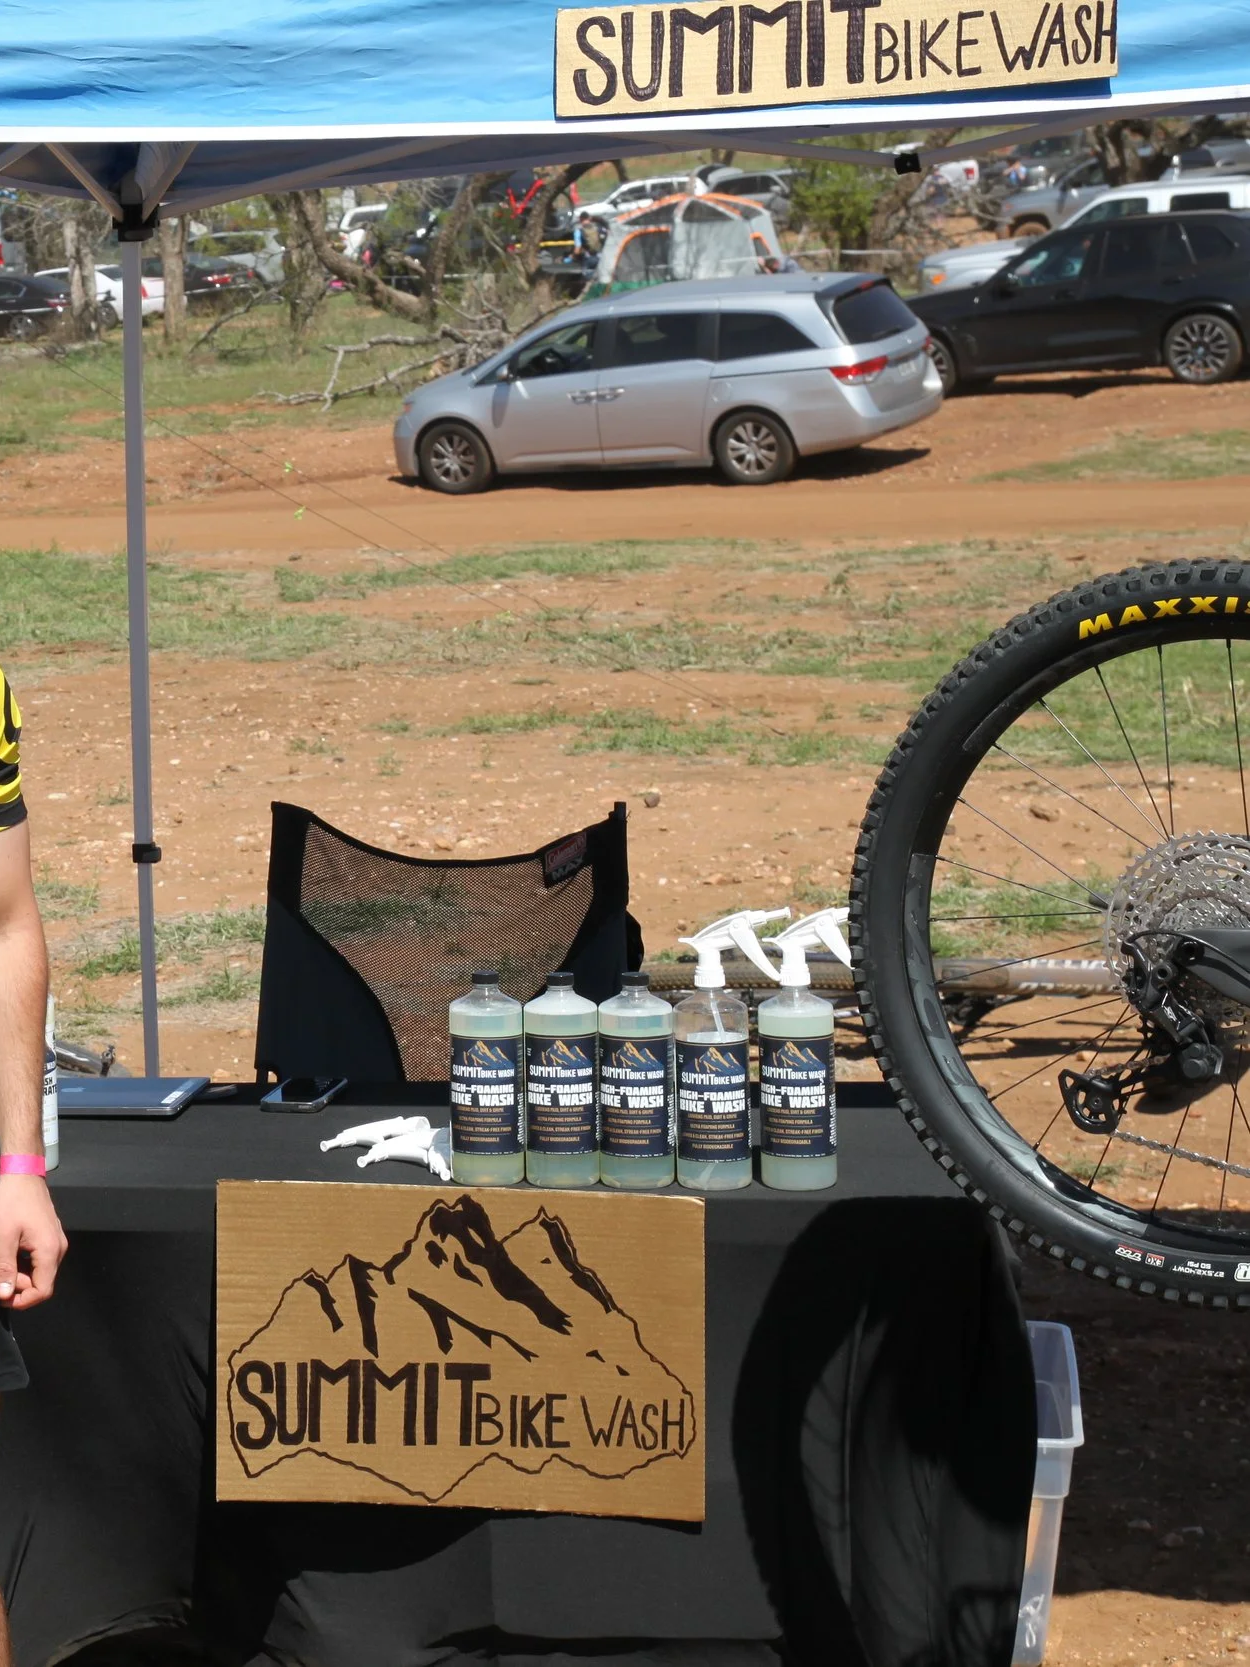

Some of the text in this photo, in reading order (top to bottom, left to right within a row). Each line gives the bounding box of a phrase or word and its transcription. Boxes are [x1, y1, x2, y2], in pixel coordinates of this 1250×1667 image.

[573, 0, 1117, 105] SUMMIT BIKE WASH
[1079, 596, 1250, 640] MAXXI
[452, 1064, 515, 1078] SUMMIT BIKE WASH
[529, 1064, 593, 1078] SUMMIT BIKE WASH
[601, 1065, 664, 1080] SUMMIT BIKE WASH
[681, 1071, 746, 1085] SUMMIT BIKE WASH
[761, 1065, 826, 1080] SUMMIT BIKE WASH
[451, 1081, 514, 1094] HIGH-FOAMING
[528, 1081, 592, 1094] HIGH-FOAMING
[600, 1083, 663, 1095] HIGH-FOAMING
[679, 1088, 745, 1101] HIGH-FOAMING
[761, 1082, 825, 1095] HIGH-FOAMING
[451, 1091, 514, 1107] BIKE WASH
[528, 1091, 593, 1107] BIKE WASH
[600, 1092, 664, 1108] BIKE WASH
[679, 1099, 746, 1114] BIKE WASH
[761, 1092, 826, 1108] BIKE WASH
[1187, 1260, 1200, 1270] PSI
[235, 1358, 686, 1452] SUMMIT BIKE WASH
